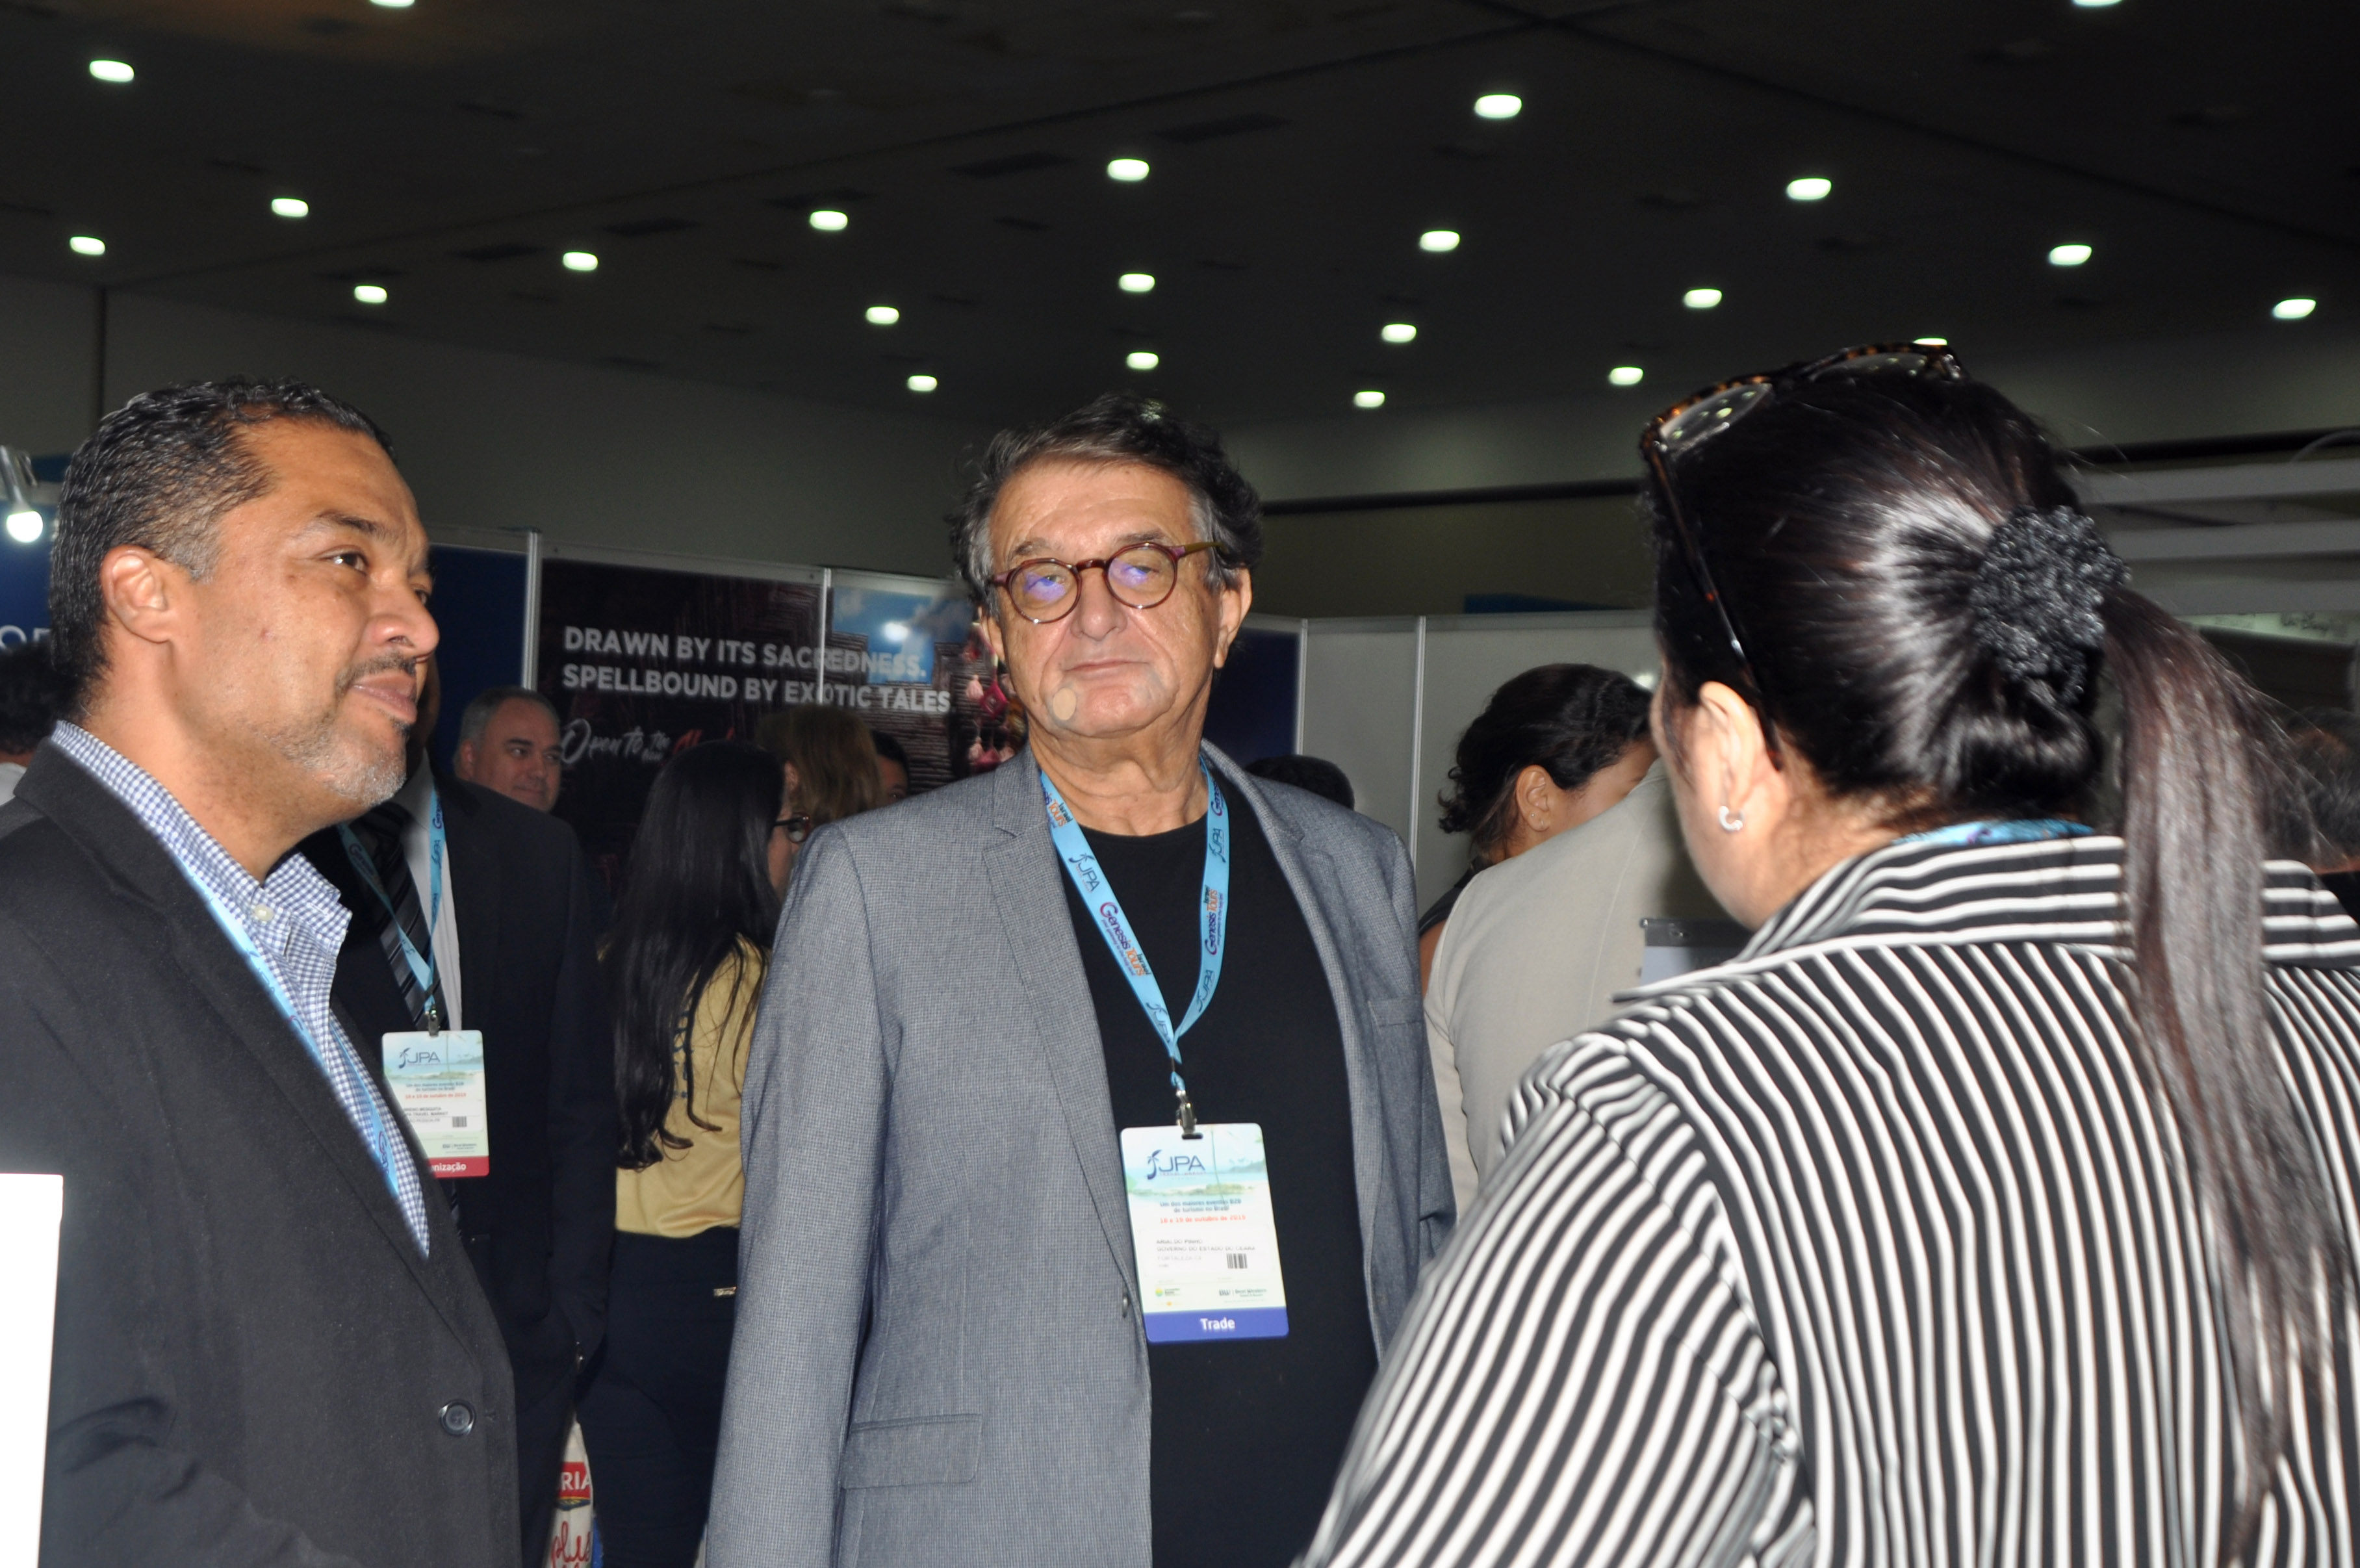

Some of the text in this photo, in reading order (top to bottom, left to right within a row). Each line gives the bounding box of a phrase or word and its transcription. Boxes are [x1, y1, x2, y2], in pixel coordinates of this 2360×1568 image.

[564, 625, 927, 677] DRAWN BY ITS SACREDNESS.
[562, 663, 951, 713] SPELLBOUND BY EXOTIC TALES
[1048, 799, 1067, 827] Tours
[1078, 862, 1100, 892] JPA
[1099, 901, 1146, 977] Genesis Tours
[1205, 912, 1218, 955] Genesis
[407, 1051, 441, 1064] JPA
[431, 1162, 467, 1173] nização
[1159, 1155, 1206, 1172] JPA
[1200, 1317, 1235, 1331] Trade
